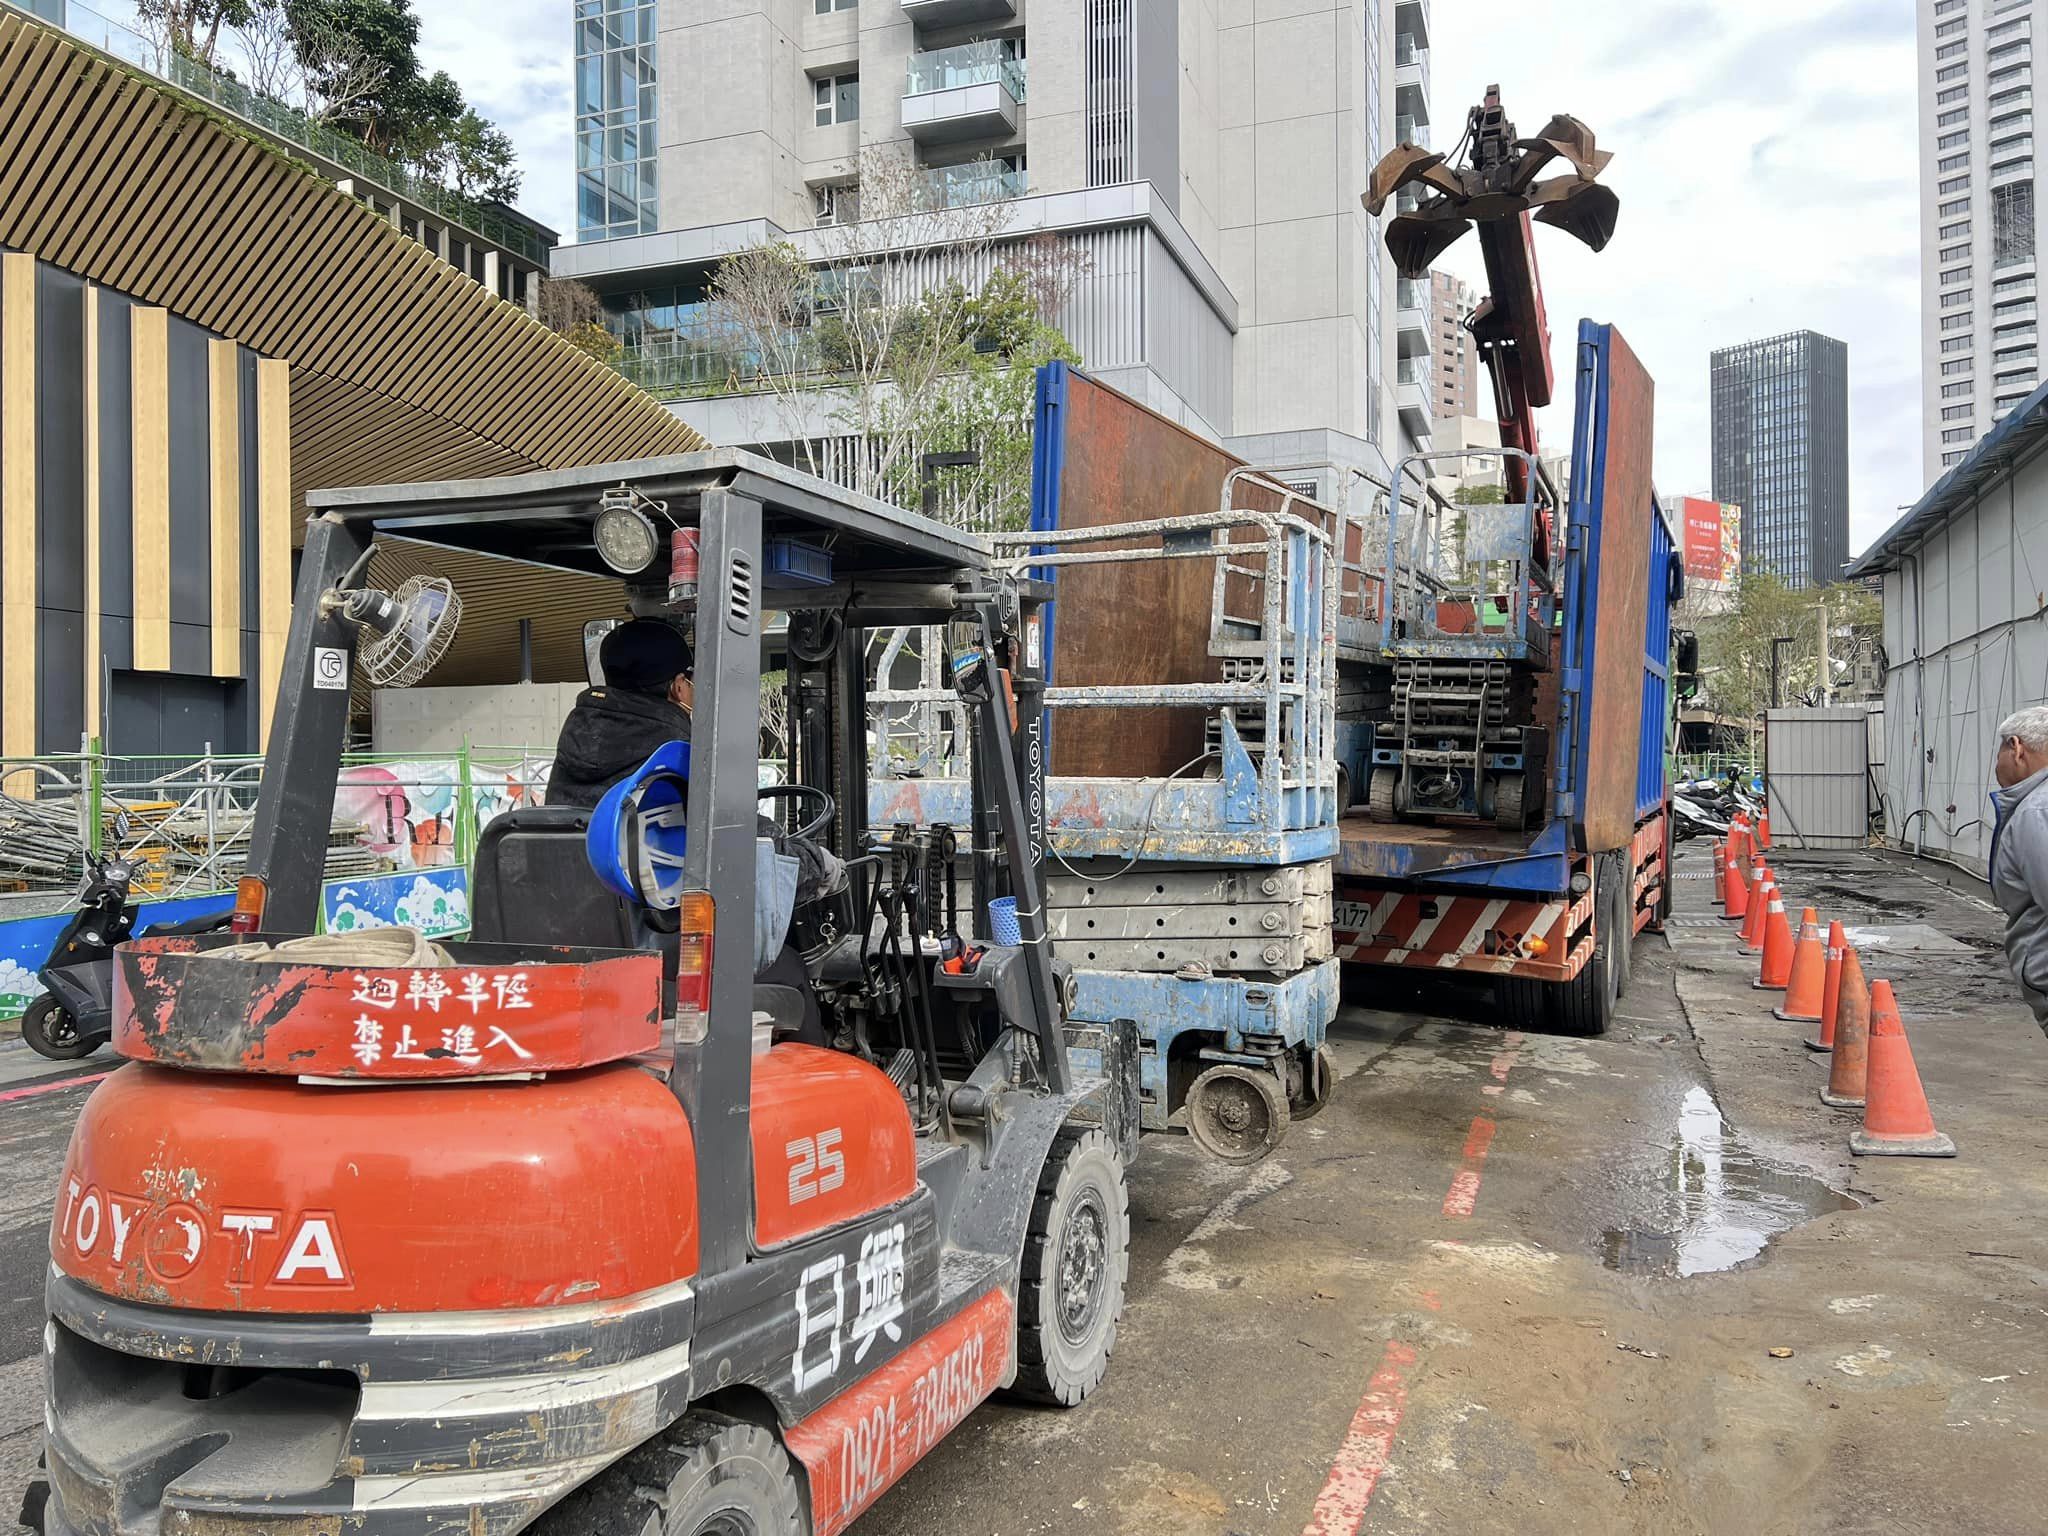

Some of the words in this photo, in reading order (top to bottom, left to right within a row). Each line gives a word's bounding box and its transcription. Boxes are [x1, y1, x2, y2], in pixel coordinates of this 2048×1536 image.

[1028, 716, 1043, 868] TOYOTA
[350, 970, 534, 1015] 迴轉半徑
[350, 1013, 534, 1066] 禁止進入
[785, 1126, 845, 1206] 25
[60, 1174, 350, 1286] TOYOTA
